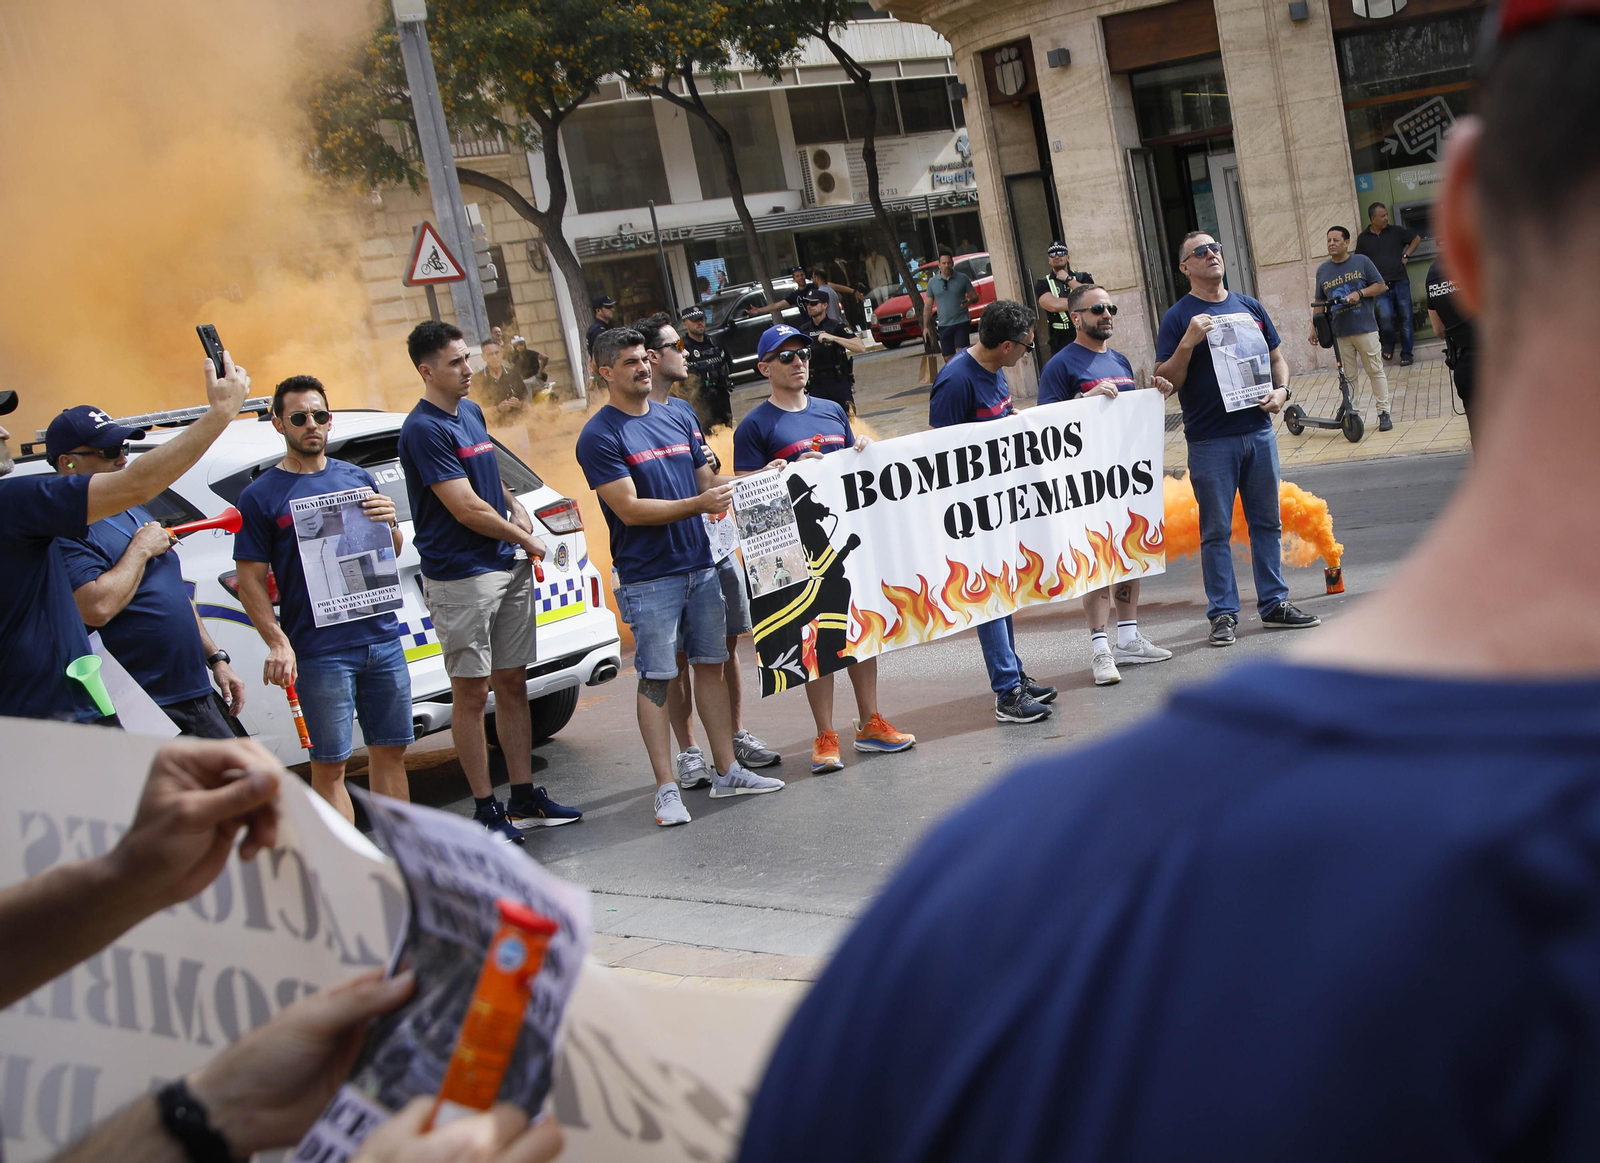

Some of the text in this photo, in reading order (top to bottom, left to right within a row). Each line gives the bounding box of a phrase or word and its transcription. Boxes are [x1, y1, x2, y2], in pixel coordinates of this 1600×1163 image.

[933, 172, 966, 189] Puerta
[886, 187, 898, 196] 733
[1323, 270, 1362, 290] Death Ride
[1429, 285, 1461, 298] NACIONAL
[841, 421, 1083, 513] BOMBEROS
[294, 498, 335, 512] DIGNIDAD
[738, 497, 762, 509] FONDOS
[943, 459, 1154, 540] QUEMADOS
[747, 536, 763, 546] HACEN
[772, 538, 799, 551] BOMBEROS
[317, 587, 397, 609] POR UNAS INSTALACIONES
[324, 605, 337, 613] QUE
[348, 600, 362, 609] DEN
